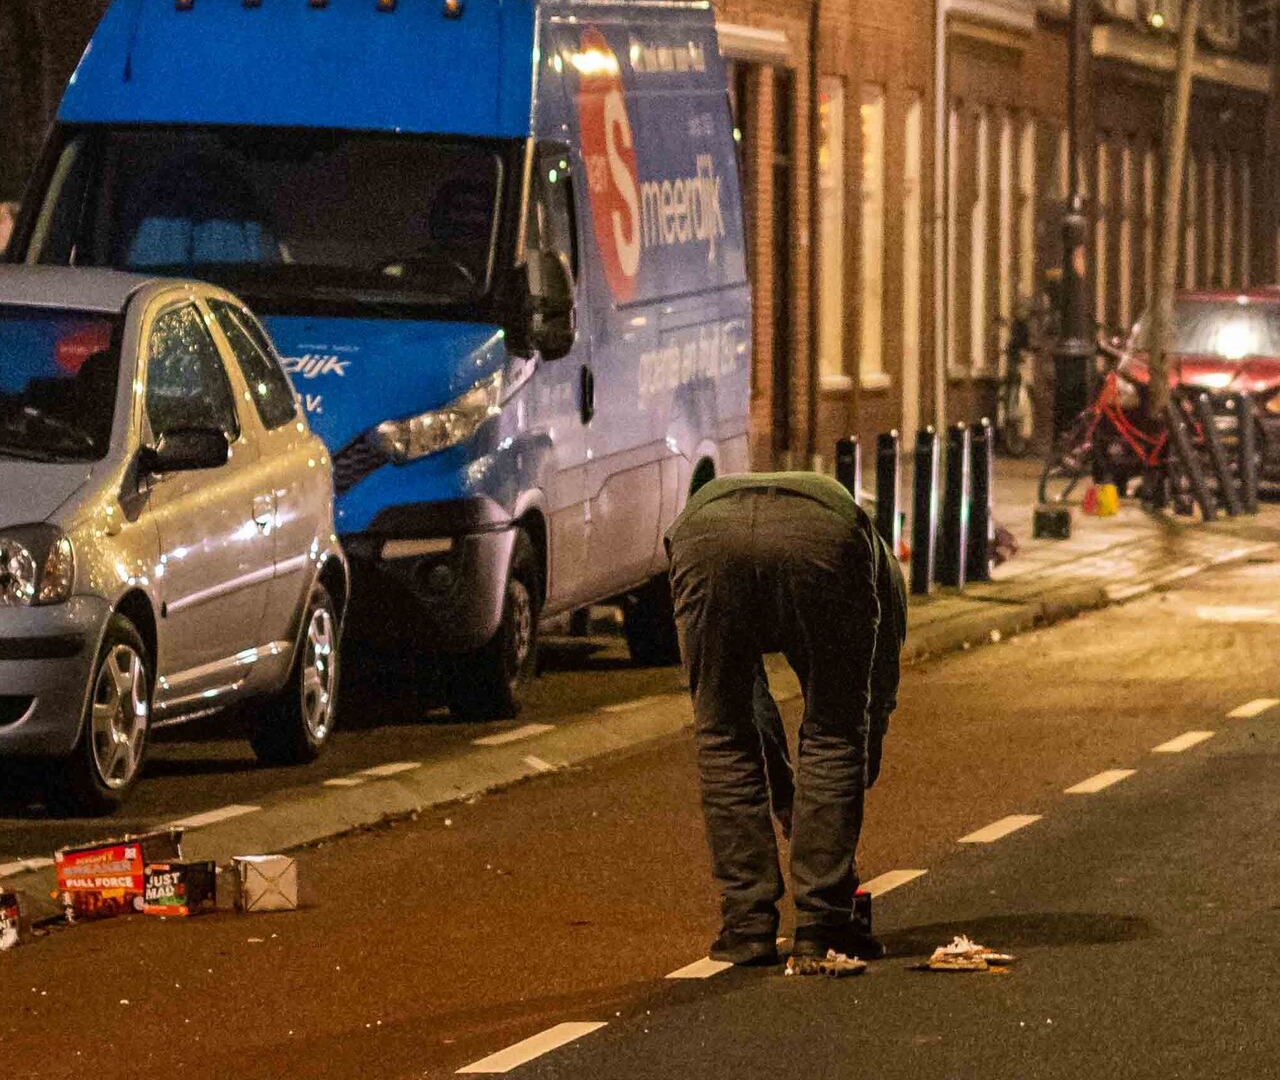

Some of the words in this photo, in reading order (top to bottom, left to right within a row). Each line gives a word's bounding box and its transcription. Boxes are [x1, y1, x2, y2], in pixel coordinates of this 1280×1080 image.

[65, 877, 95, 888] FULL
[95, 876, 134, 888] FORCE
[146, 872, 180, 888] JUST
[145, 885, 175, 900] MAD
